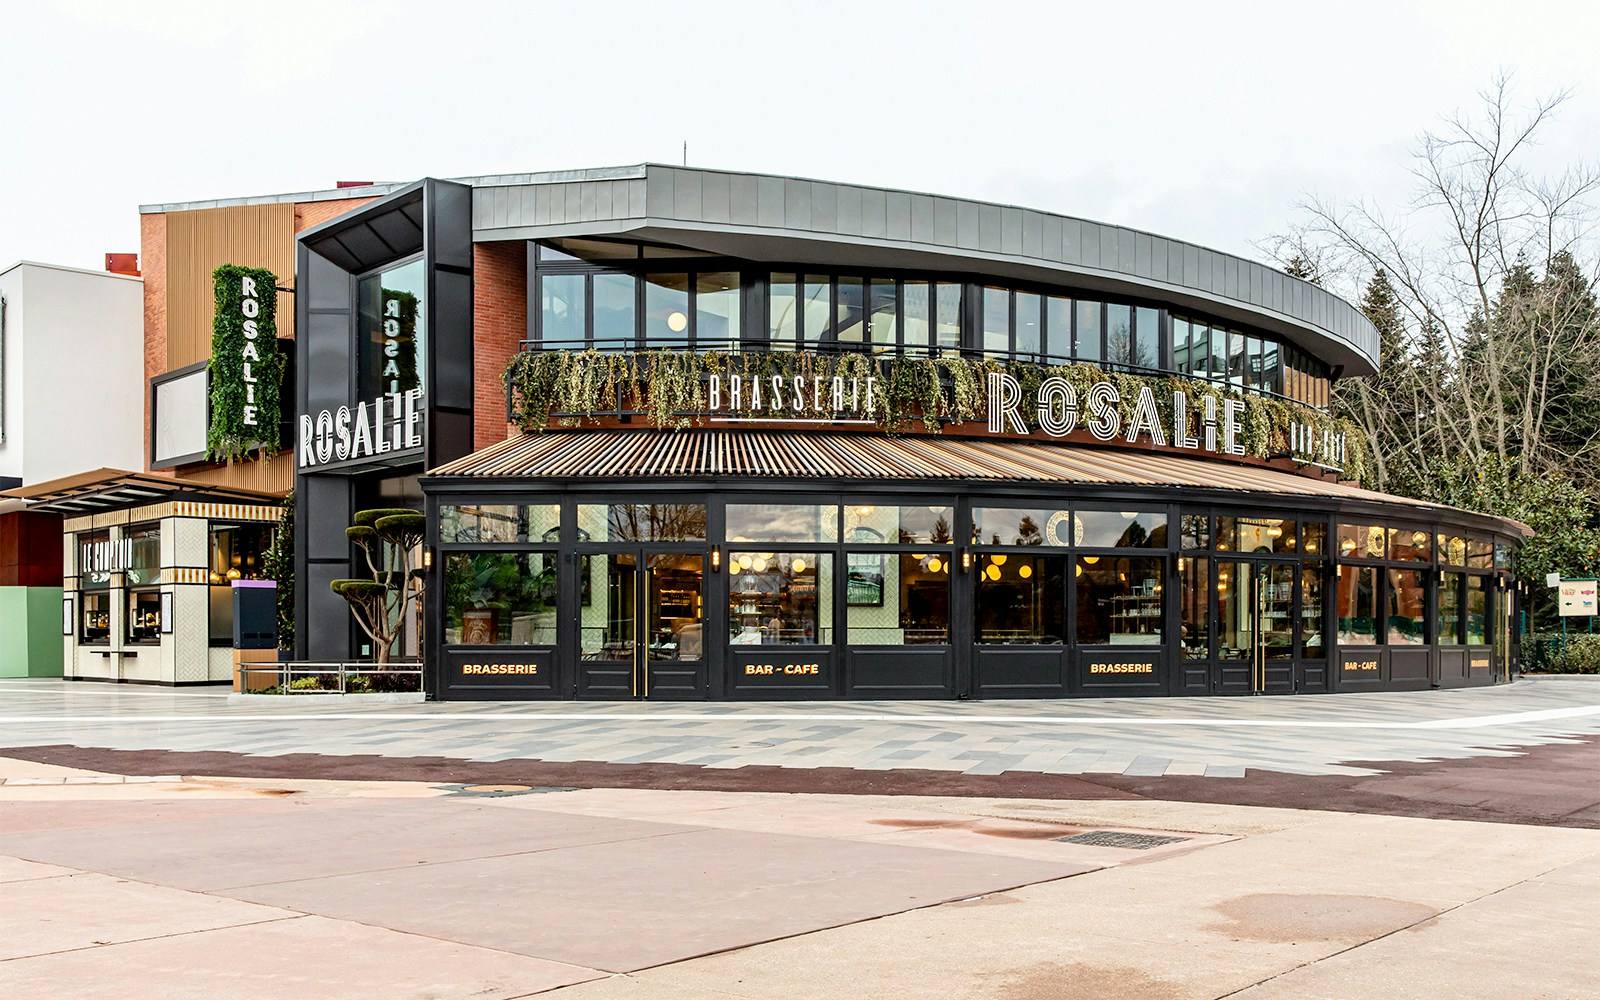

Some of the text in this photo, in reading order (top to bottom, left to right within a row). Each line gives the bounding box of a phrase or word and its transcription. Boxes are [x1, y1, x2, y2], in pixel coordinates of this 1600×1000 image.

[242, 277, 259, 425] ROSALIE
[710, 375, 876, 412] BRASSERIE
[988, 373, 1246, 456] ROSALIE
[300, 388, 422, 467] ROSALIE
[463, 664, 538, 675] BRASSERIE
[745, 664, 774, 675] BAR
[1090, 663, 1153, 674] BRASSERIE
[1345, 662, 1357, 670] BAR
